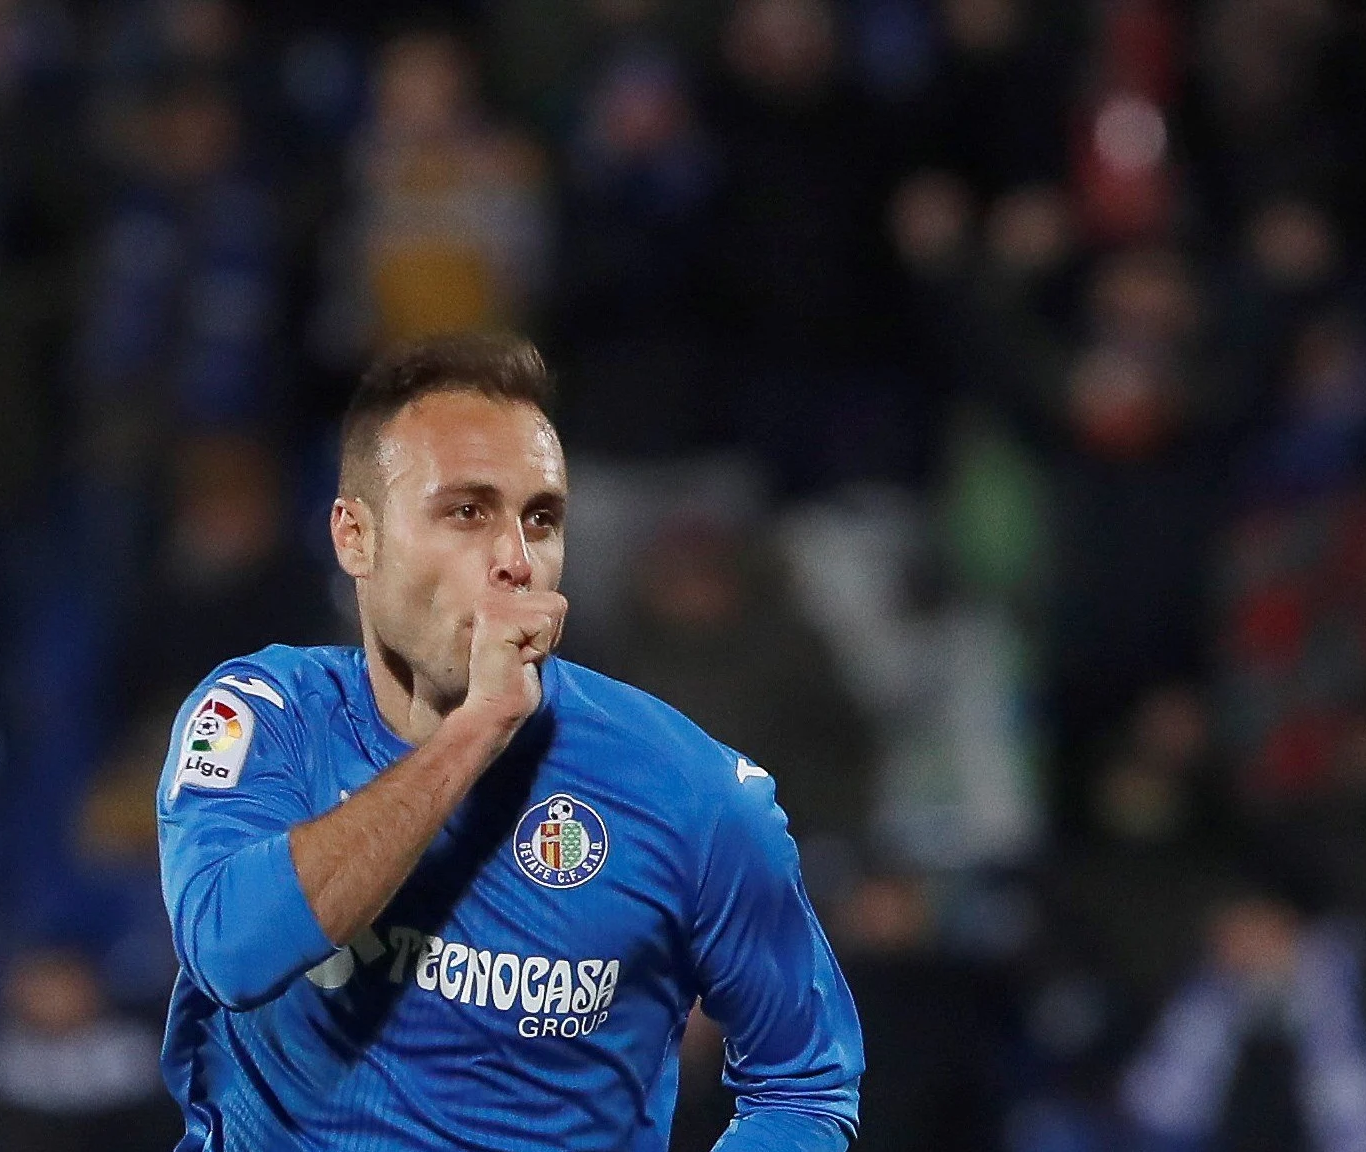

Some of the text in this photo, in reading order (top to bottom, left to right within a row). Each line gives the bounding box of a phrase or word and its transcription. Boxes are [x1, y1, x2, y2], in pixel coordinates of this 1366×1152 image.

[186, 756, 230, 778] Liga
[519, 842, 551, 879] GETAFE
[390, 926, 620, 1014] TECNOCASA
[519, 1011, 608, 1038] GROUP
